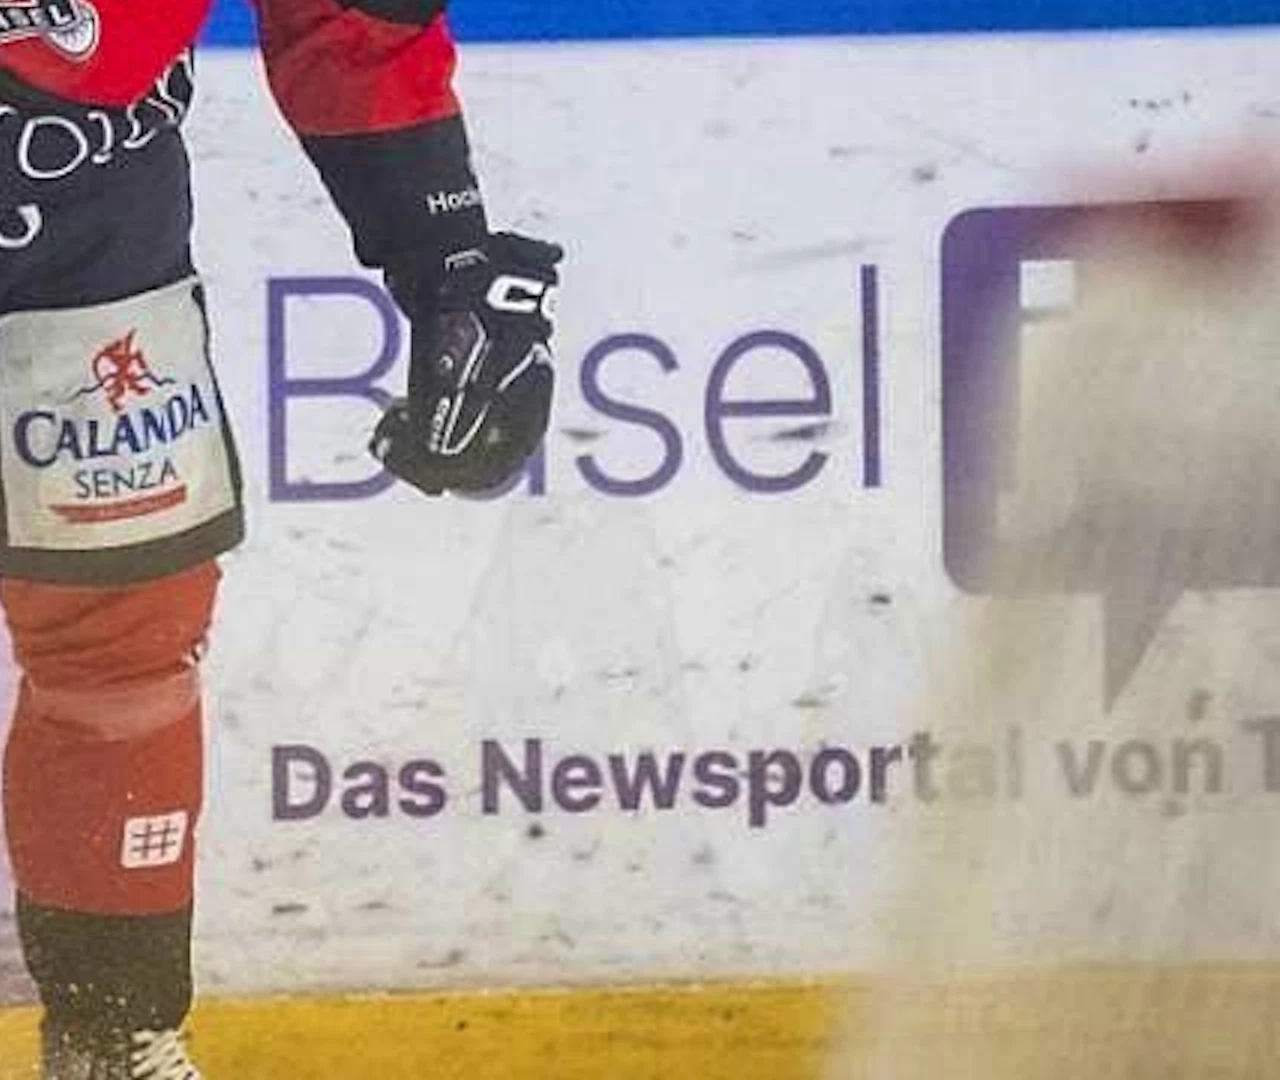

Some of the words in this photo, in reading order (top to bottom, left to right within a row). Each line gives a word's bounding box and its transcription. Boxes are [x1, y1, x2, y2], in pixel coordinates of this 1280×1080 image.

[13, 383, 210, 468] CALANDA
[266, 263, 884, 505] Bsel
[73, 457, 179, 498] SENZA
[270, 744, 448, 821] Das
[480, 726, 1023, 828] Newsportal
[1053, 736, 1225, 800] von
